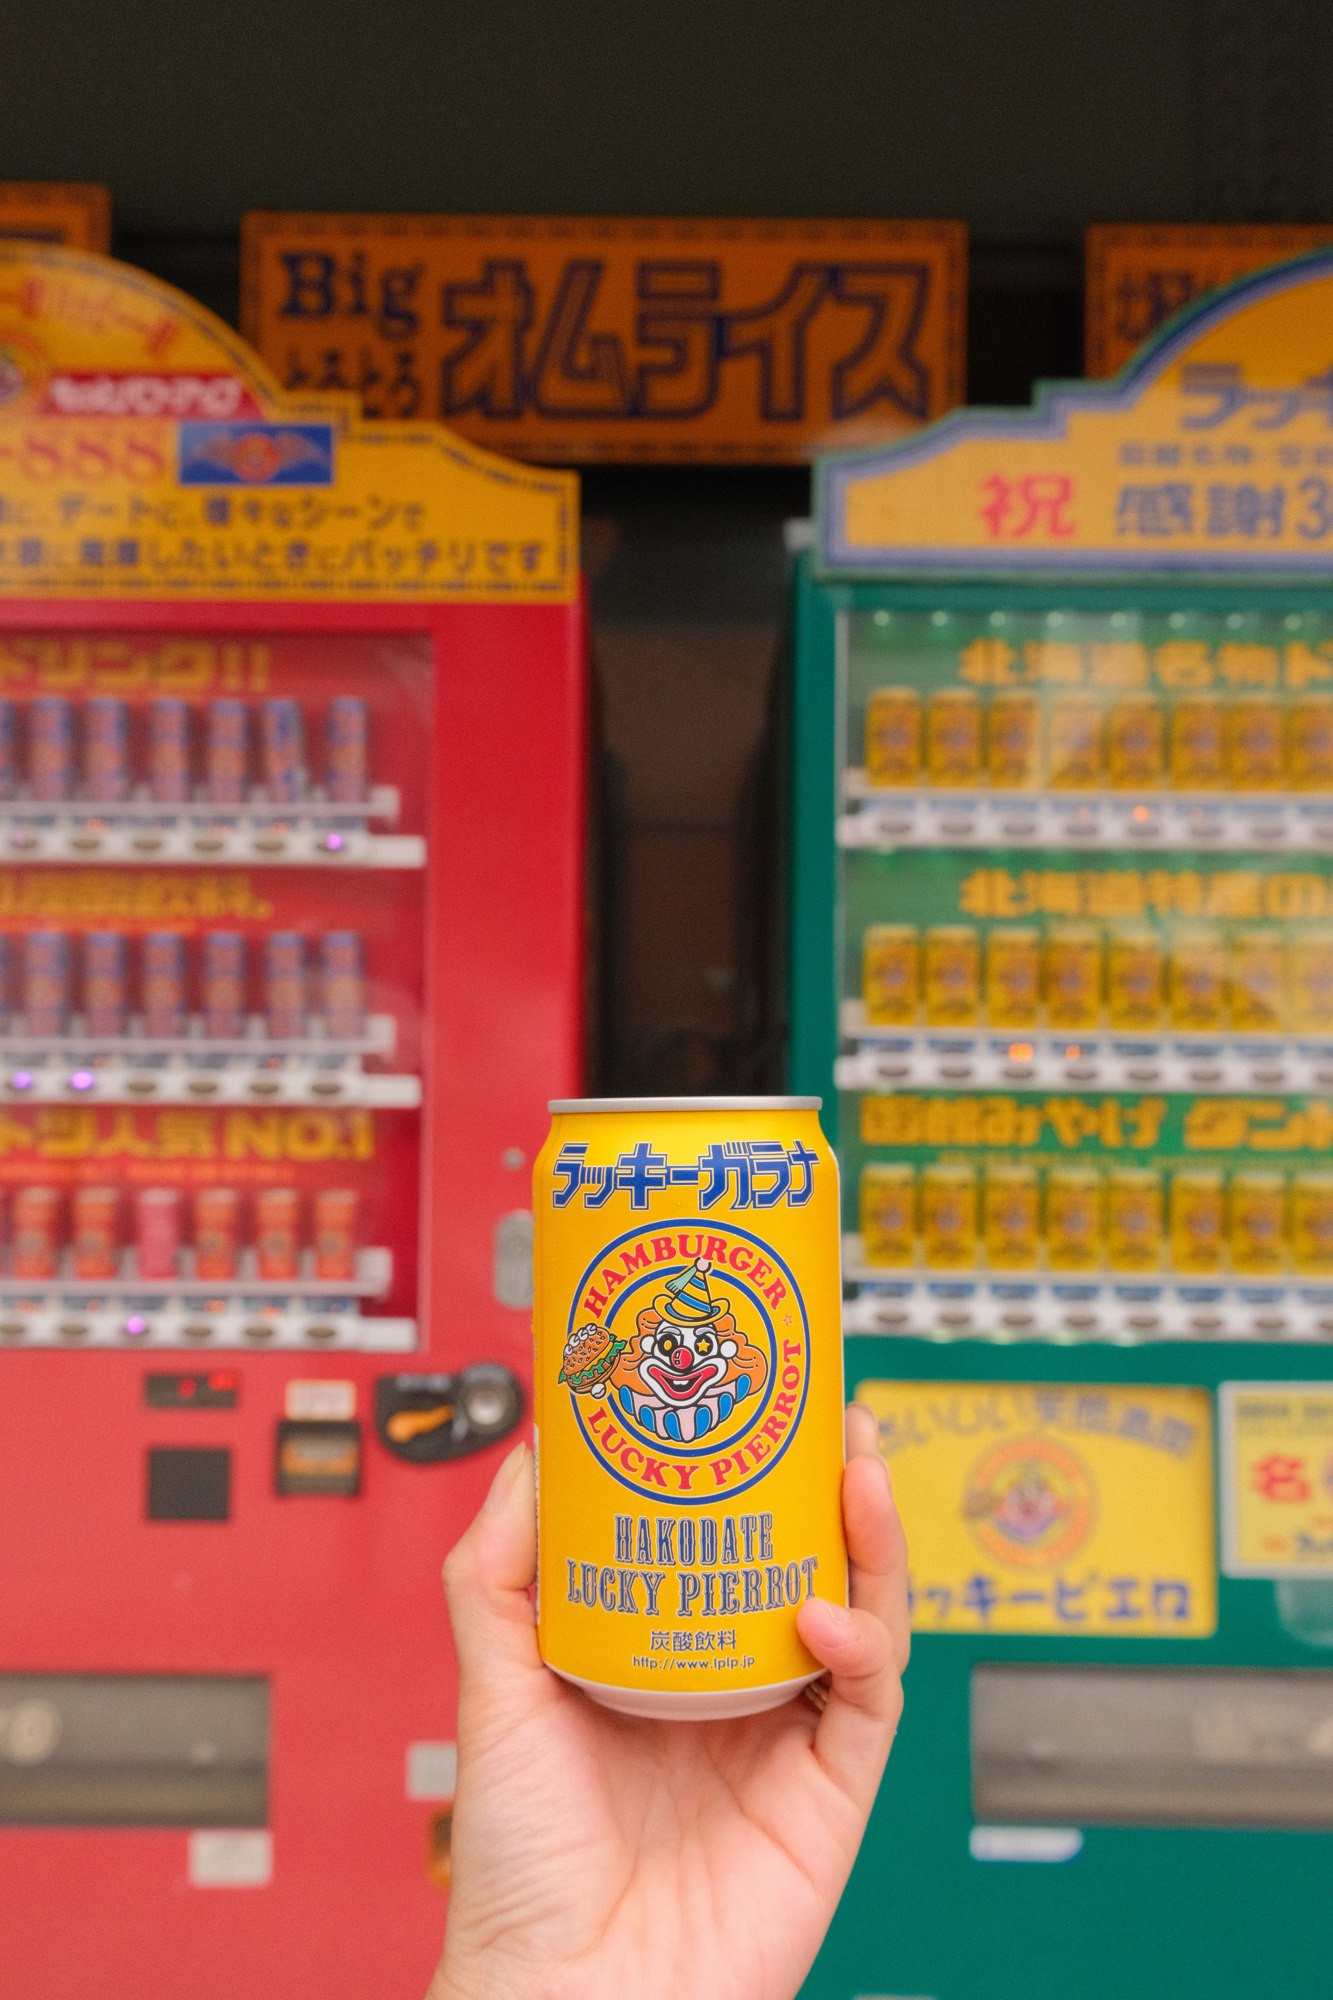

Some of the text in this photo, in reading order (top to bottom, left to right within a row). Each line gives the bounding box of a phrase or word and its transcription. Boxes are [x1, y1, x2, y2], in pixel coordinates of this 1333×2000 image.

[279, 250, 425, 342] Big
[440, 256, 934, 426] オムライス
[976, 474, 1076, 540] 祝
[552, 1139, 821, 1211] ラッキーガラナ
[583, 1233, 788, 1319] HAMBURGER
[587, 1406, 701, 1490] LUCKY
[708, 1338, 802, 1487] PIERROT
[614, 1511, 774, 1566] HAKODATE
[565, 1555, 819, 1618] LUCKY PIERROT
[908, 1572, 1191, 1623] ッキーピエロ
[632, 1655, 756, 1671] http://www.lplp.jp
[649, 1628, 738, 1652] 炭酸飲料
